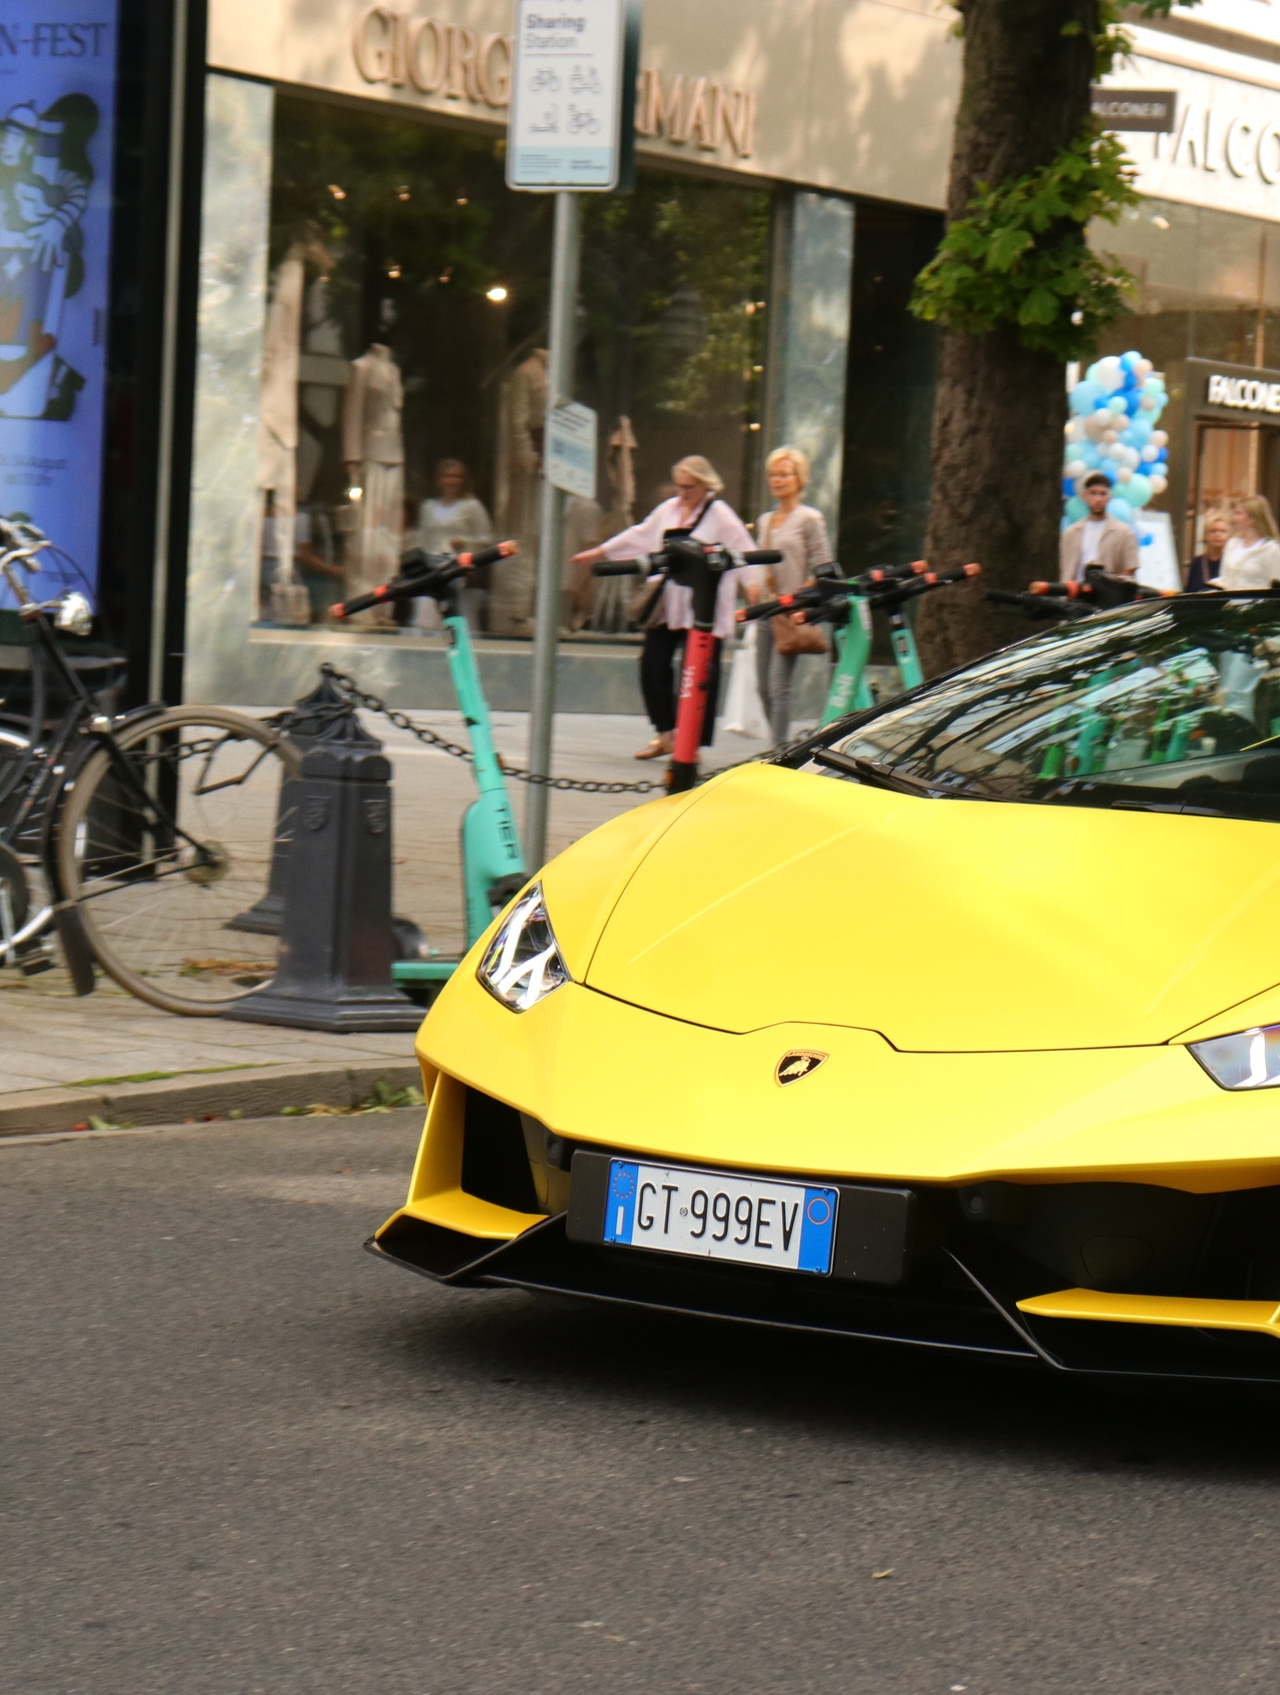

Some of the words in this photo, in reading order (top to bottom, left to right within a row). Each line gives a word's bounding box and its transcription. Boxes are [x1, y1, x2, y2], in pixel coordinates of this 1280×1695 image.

[525, 12, 586, 33] Sharing
[523, 32, 577, 48] Station
[494, 802, 520, 860] TIER
